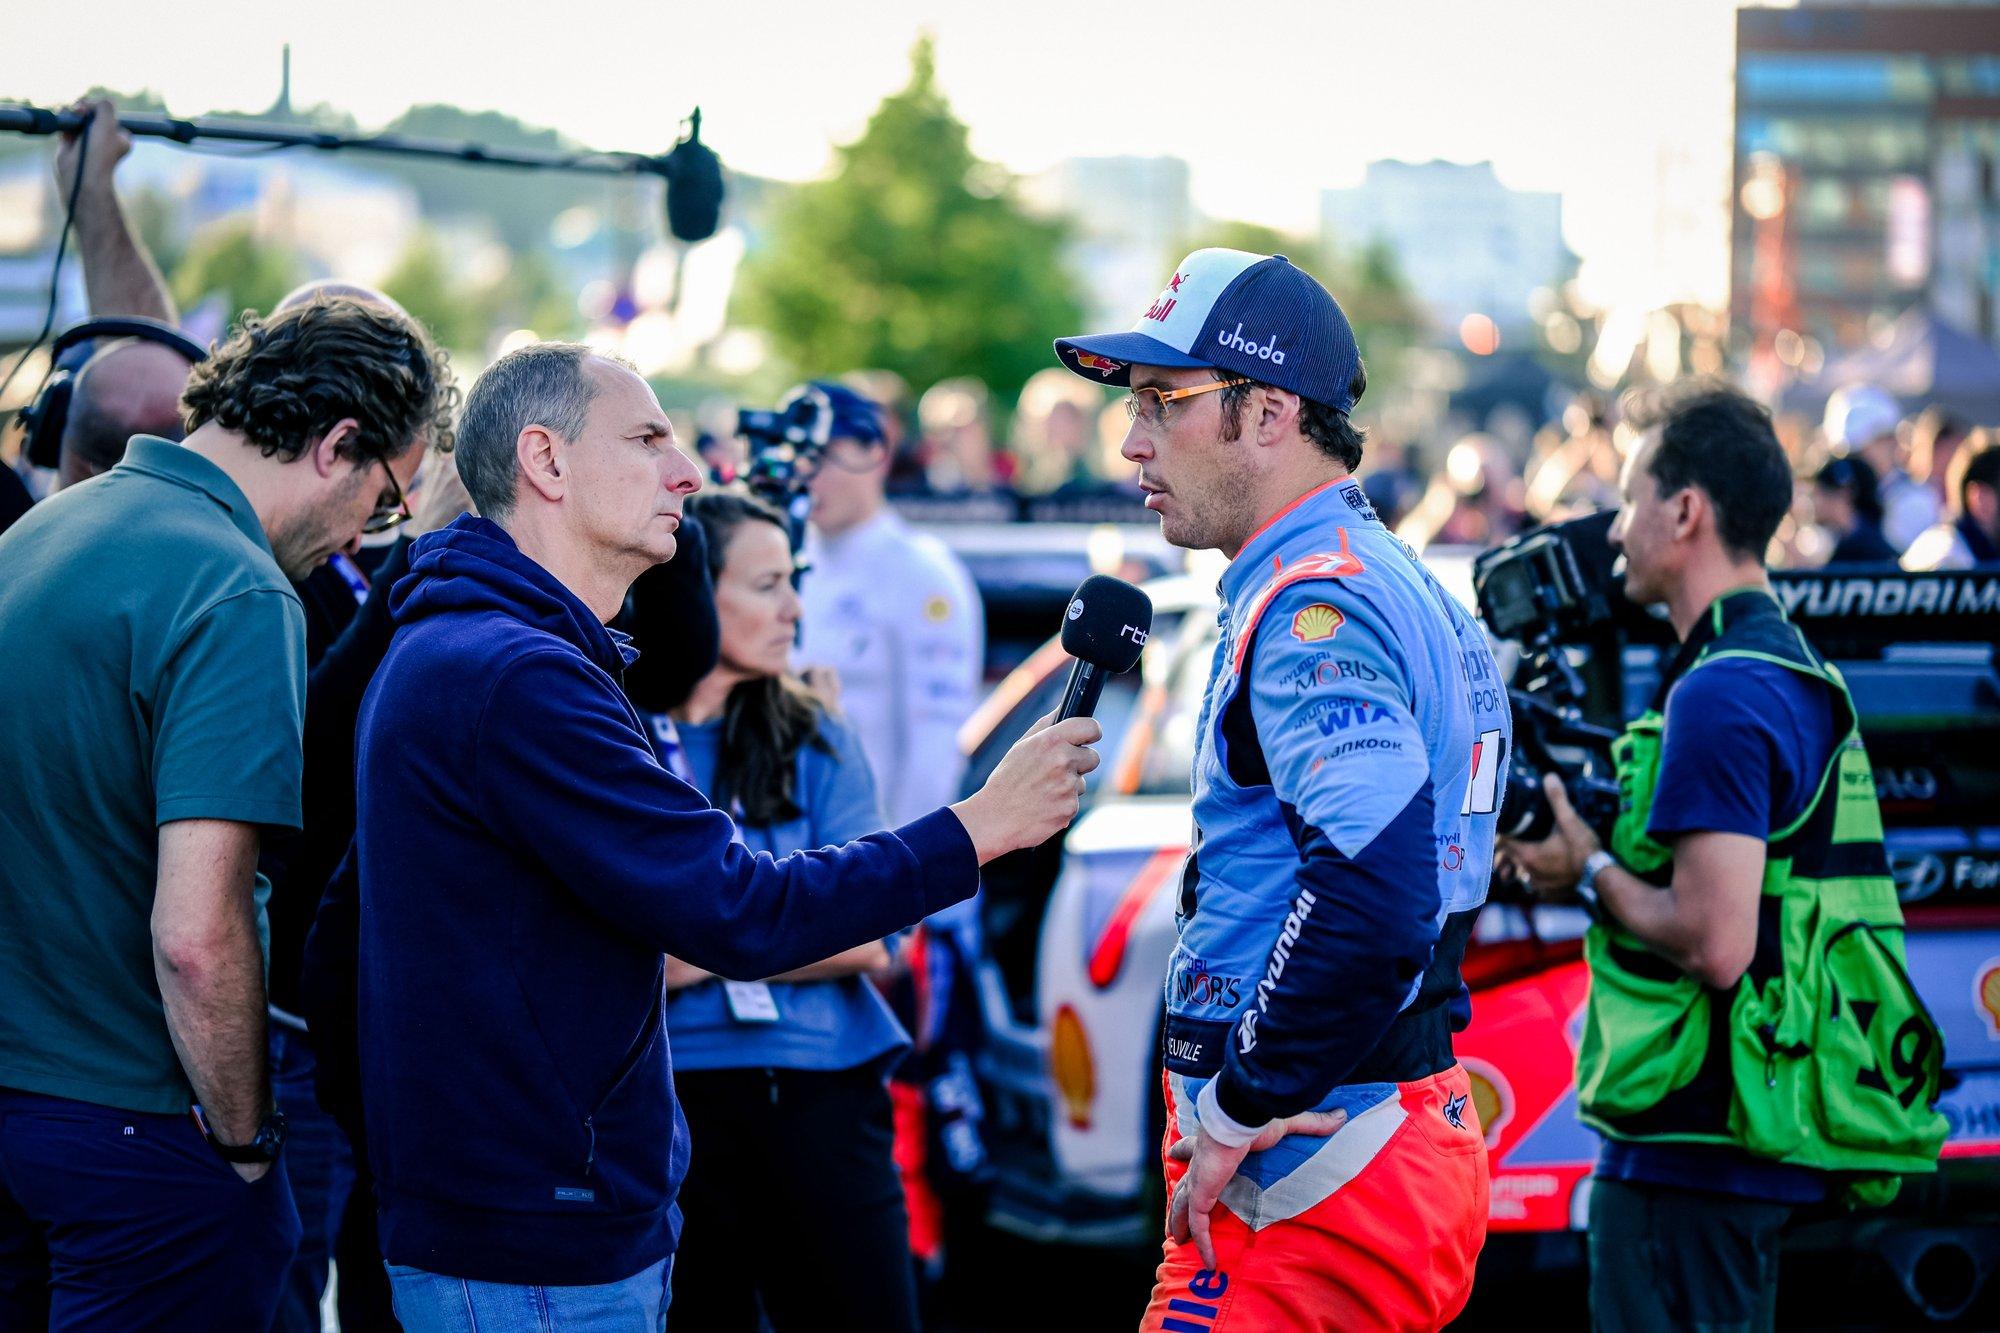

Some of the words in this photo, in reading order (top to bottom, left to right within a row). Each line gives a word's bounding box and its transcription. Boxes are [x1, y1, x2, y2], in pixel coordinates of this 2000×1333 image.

[1218, 322, 1285, 365] uhoda
[1781, 578, 1955, 617] YUNDAI
[1957, 578, 2000, 615] M
[1279, 651, 1331, 687] HYUNDAI
[1295, 660, 1378, 696] MOBIS
[1294, 698, 1356, 731] HYUNDAI
[1316, 702, 1400, 737] WIA
[1257, 888, 1317, 1014] HYUNDAI
